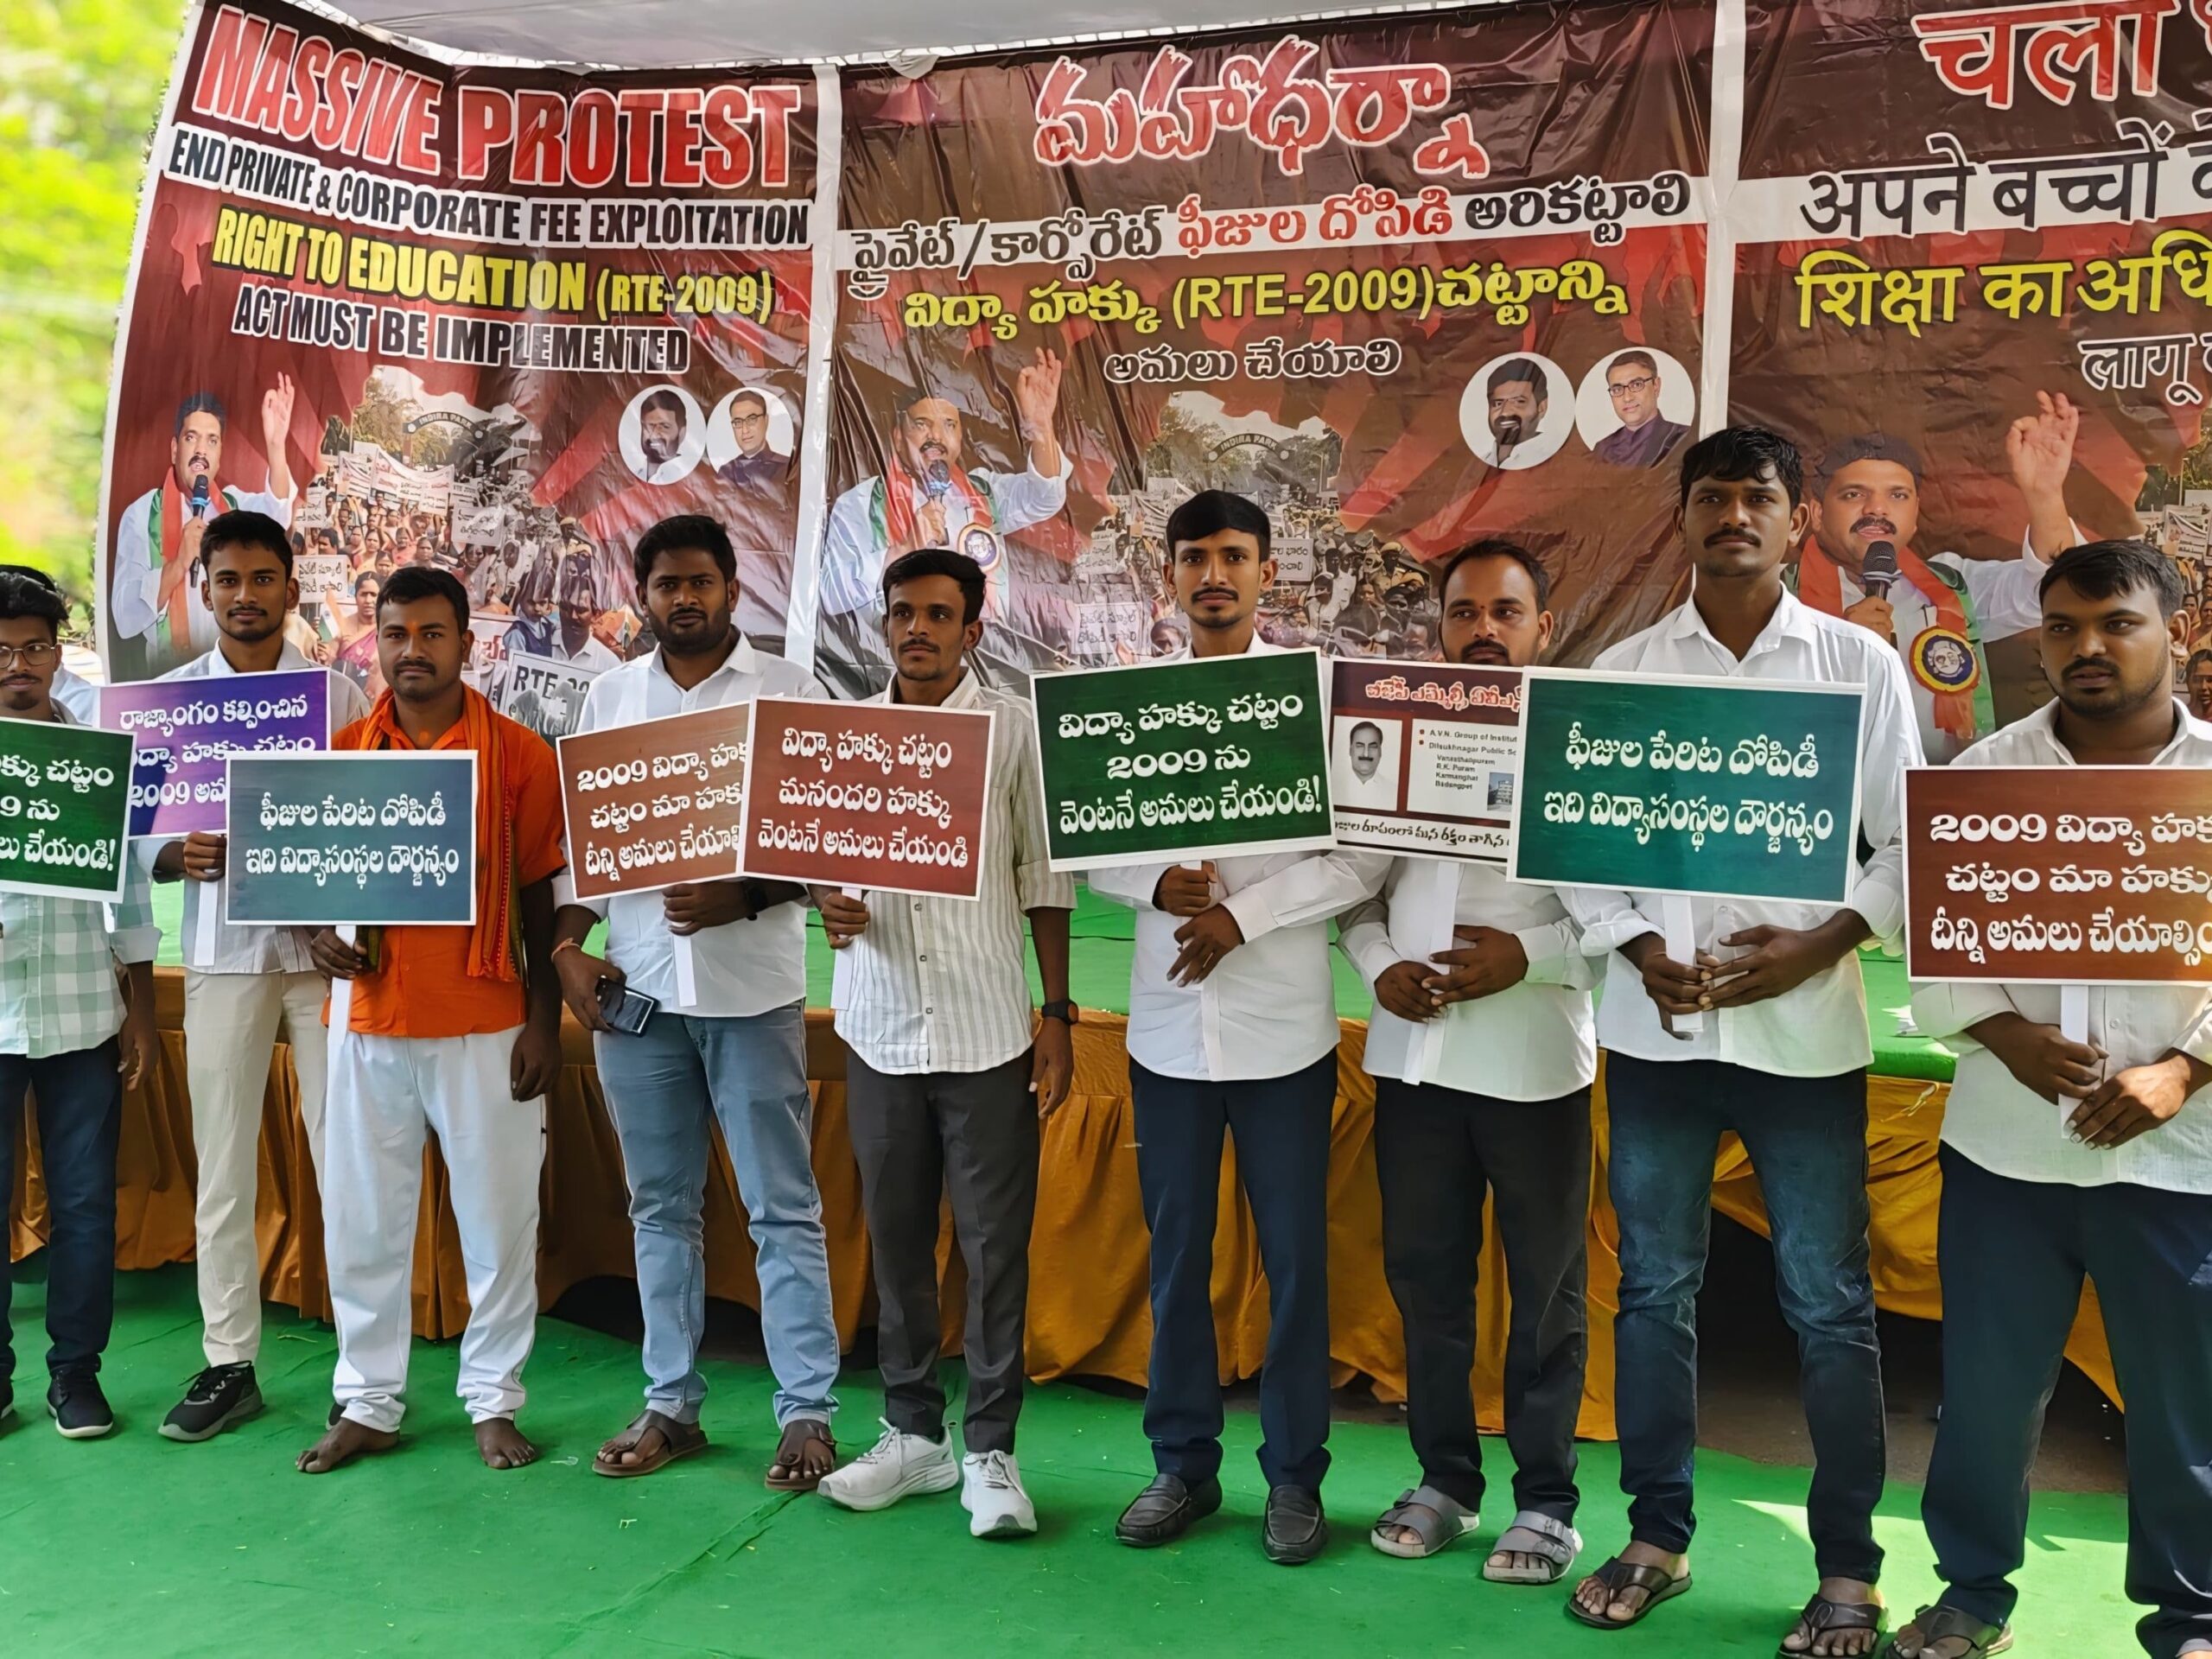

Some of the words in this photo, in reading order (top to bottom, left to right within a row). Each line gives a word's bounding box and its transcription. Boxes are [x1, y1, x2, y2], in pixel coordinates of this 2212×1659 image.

[194, 7, 442, 174] MASSIVE
[455, 85, 800, 190] PROTEST
[171, 128, 222, 175] END
[229, 144, 315, 207] PRIVATE
[316, 177, 332, 208] &
[335, 178, 520, 241] CORPORATE
[531, 204, 580, 243] FEE
[590, 203, 809, 245] EXPLOITATION
[1800, 132, 1977, 239] अपने
[1989, 118, 2172, 230] बच्चों
[1178, 194, 1306, 257] ఫీజుల
[1319, 184, 1452, 242] దోపిడి
[1466, 172, 1690, 245] అరికట్టాలి
[213, 207, 302, 283] RIGHT
[307, 228, 341, 287] TO
[347, 240, 586, 314] EDUCATION
[596, 267, 772, 324] (RTE-2009)
[904, 289, 1018, 340] విద్యా
[1028, 278, 1162, 335] హక్కు
[1795, 250, 1965, 338] शिक्षा
[1979, 262, 2072, 320] का
[234, 284, 286, 336] ACT
[289, 296, 373, 352] MUST
[381, 310, 427, 358] BE
[435, 317, 690, 373] IMPLEMENTED
[1103, 340, 1236, 383] అమలు
[1244, 337, 1402, 378] చేయాలి
[2078, 333, 2202, 406] लागू
[119, 700, 219, 738] రాజ్యాంగం
[223, 695, 308, 728] కల్పించిన
[1058, 712, 1135, 744] విద్యా
[1138, 701, 1223, 734] హక్కు
[1227, 693, 1303, 729] చట్టం
[577, 760, 647, 791] 2009
[652, 753, 709, 781] విద్యా
[782, 728, 832, 772] విద్యా
[836, 729, 893, 774] హక్కు
[899, 734, 951, 779] చట్టం
[1107, 749, 1207, 779] 2009
[1215, 745, 1250, 770] ను
[1566, 721, 1643, 770] ఫీజుల
[1649, 730, 1722, 772] పేరిట
[1729, 734, 1819, 778] దోపిడీ
[47, 760, 114, 793] చట్టం
[27, 799, 60, 821] ను
[260, 791, 317, 830] ఫీజుల
[322, 795, 376, 826] పేరిట
[590, 803, 647, 833] చట్టం
[652, 795, 690, 817] మా
[779, 778, 881, 811] మనందరి
[887, 786, 952, 829] హక్కు
[1060, 789, 1135, 834] వెంటనే
[1140, 792, 1214, 826] అమలు
[1219, 775, 1321, 819] చేయండి!
[1544, 791, 1585, 823] ఇది
[1734, 800, 1834, 855] దౌర్జన్యం
[24, 829, 116, 871] చేయండి!
[586, 842, 620, 881] దీన్ని
[619, 838, 676, 869] అమలు
[759, 818, 820, 852] వెంటనే
[823, 828, 884, 859] అమలు
[888, 826, 968, 868] చేయండి
[1930, 814, 2047, 842] 2009
[2056, 815, 2145, 856] విద్యా
[246, 848, 276, 874] ఇది
[1946, 862, 2040, 902] చట్టం
[2050, 864, 2113, 892] మా
[1931, 906, 1986, 963] దీన్ని
[1987, 914, 2082, 951] అమలు
